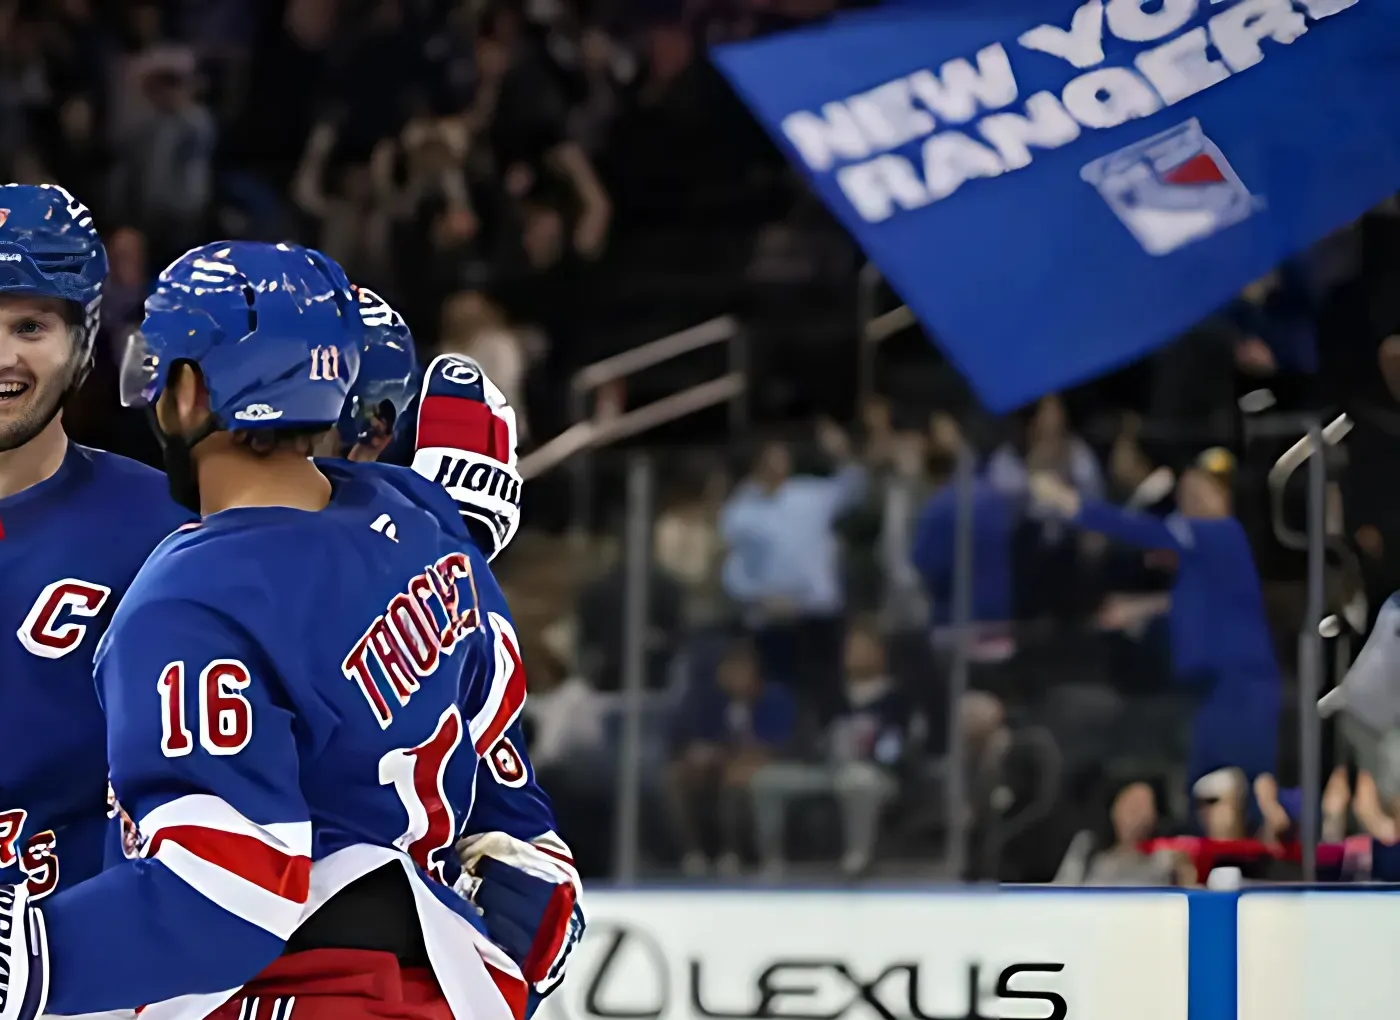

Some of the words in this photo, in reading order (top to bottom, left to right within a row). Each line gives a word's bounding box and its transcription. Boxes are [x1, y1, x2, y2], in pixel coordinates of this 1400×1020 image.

[781, 41, 1018, 172] NEW
[1018, 0, 1212, 69] YO
[16, 578, 112, 659] C
[156, 658, 253, 758] 16
